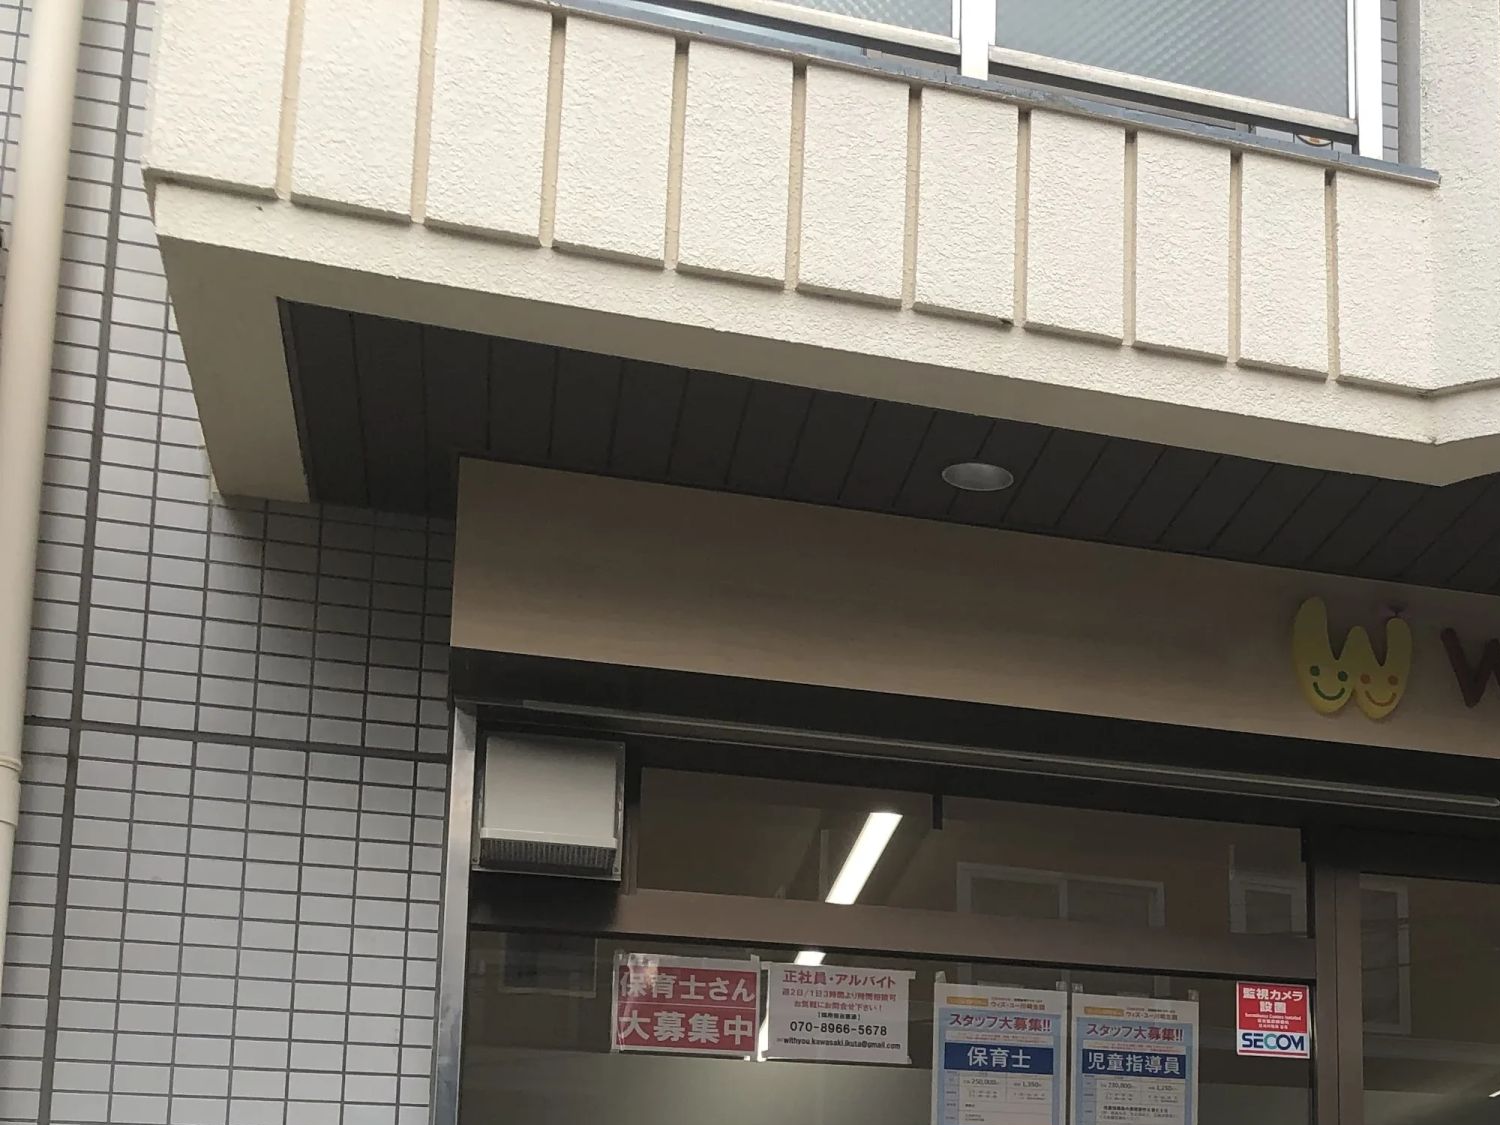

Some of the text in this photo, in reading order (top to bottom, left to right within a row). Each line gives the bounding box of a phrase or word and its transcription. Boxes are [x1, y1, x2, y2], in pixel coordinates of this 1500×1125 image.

[619, 971, 755, 1002] 保育士さん
[782, 969, 896, 989] 正社員・アルバイト
[1242, 987, 1303, 1002] 監視カメラ
[618, 1010, 754, 1045] 大募集中
[790, 1021, 887, 1036] 070-8966-5678
[950, 1013, 1051, 1033] スタッフ大募集!!
[1086, 1023, 1184, 1042] スタッフ大募集!!
[1242, 1033, 1304, 1051] SECOM
[967, 1046, 1031, 1069] 保育士
[1088, 1052, 1181, 1075] 児童指導員
